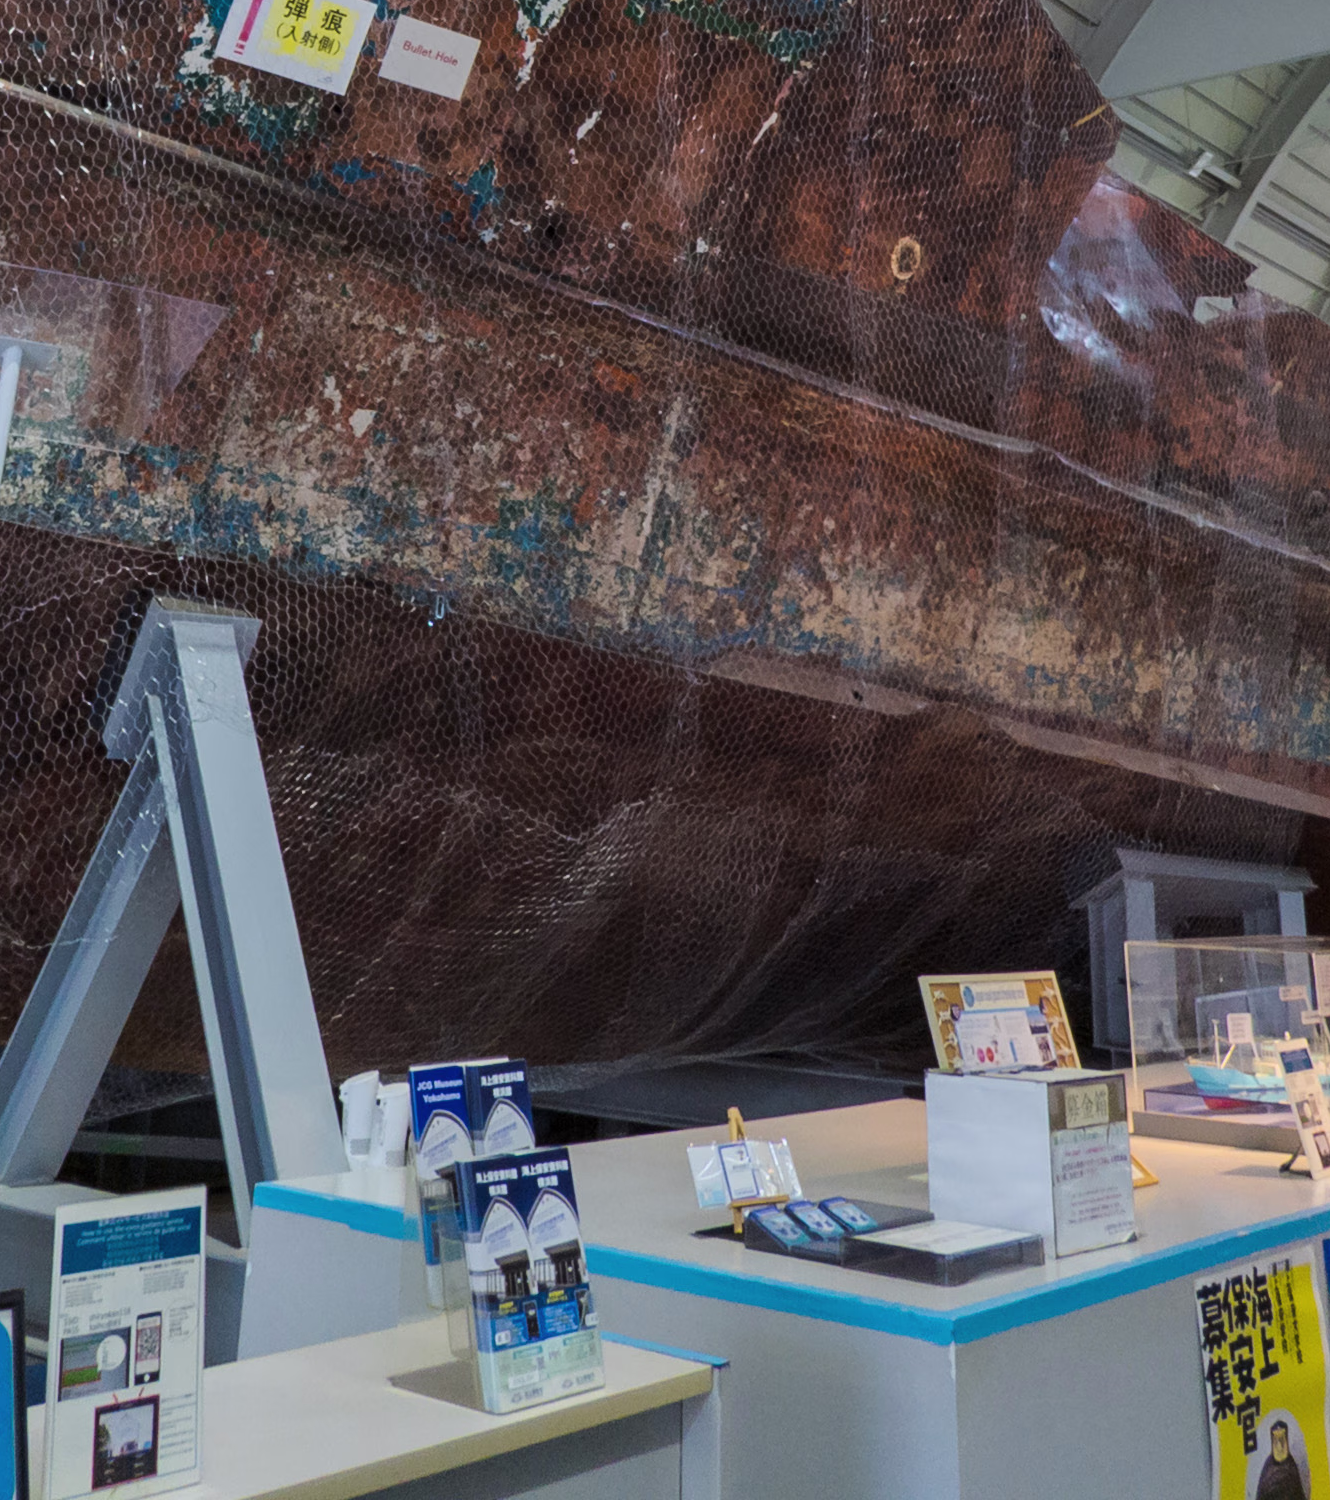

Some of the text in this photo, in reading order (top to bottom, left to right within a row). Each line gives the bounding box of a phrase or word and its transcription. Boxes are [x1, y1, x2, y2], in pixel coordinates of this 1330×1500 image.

[403, 40, 458, 66] Bullet Hole
[417, 1080, 433, 1091] JCG
[1196, 1281, 1235, 1424] 募集
[1223, 1274, 1261, 1456] 保安官
[1246, 1266, 1280, 1381] 海上
